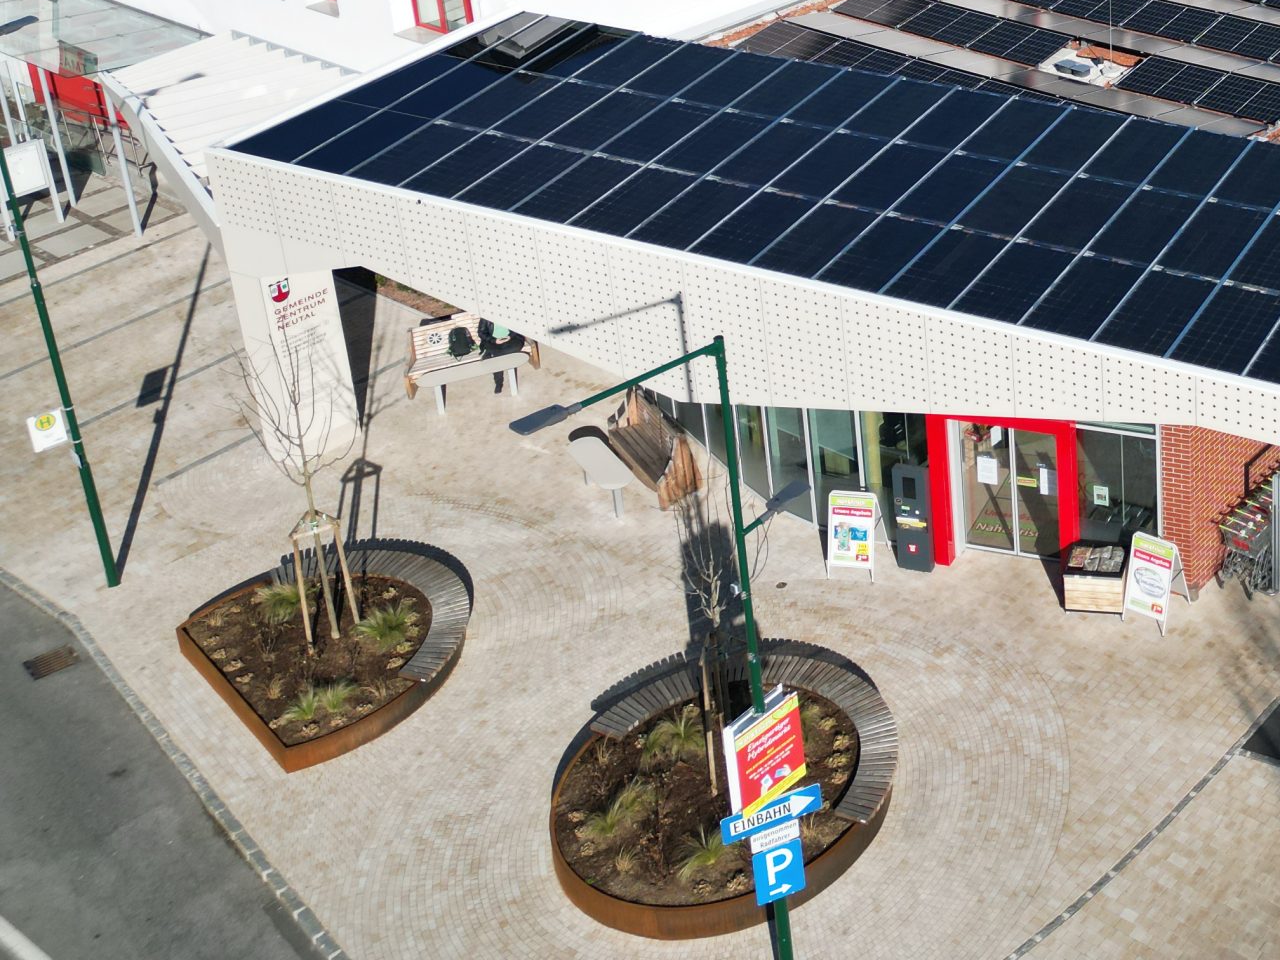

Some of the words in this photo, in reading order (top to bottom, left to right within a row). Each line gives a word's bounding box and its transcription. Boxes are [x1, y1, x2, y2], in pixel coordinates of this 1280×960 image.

[274, 288, 329, 315] GEMEINDE
[276, 298, 326, 323] ZENTRUM
[277, 311, 316, 331] NEUTAL
[40, 416, 51, 429] H
[733, 802, 792, 834] EINBAHN
[752, 822, 797, 843] ausgenommen
[760, 833, 790, 848] Radfahrer
[765, 847, 793, 886] P
